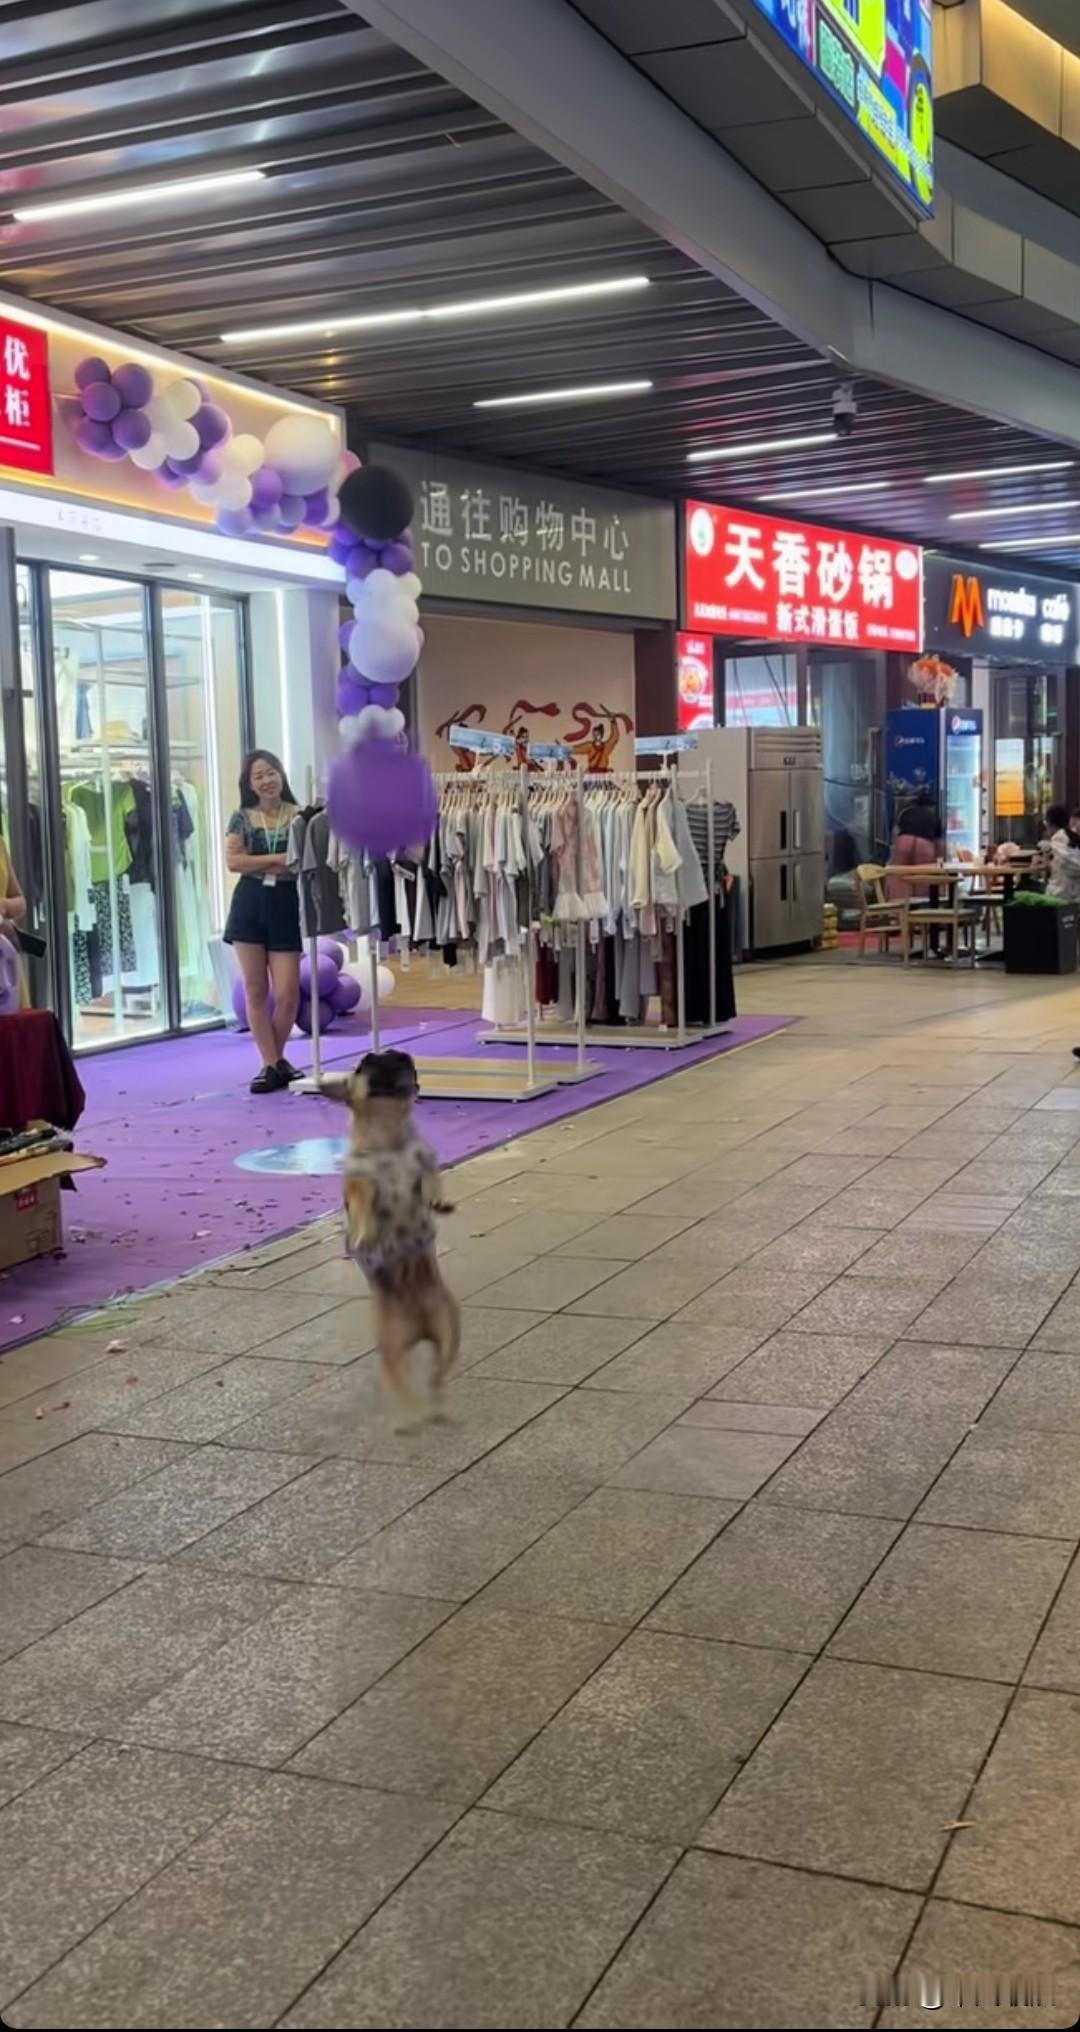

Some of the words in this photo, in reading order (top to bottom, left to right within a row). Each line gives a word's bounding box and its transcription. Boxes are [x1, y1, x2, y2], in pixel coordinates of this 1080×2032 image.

[420, 480, 629, 561] 通往购物中心
[421, 542, 452, 571] TO
[460, 547, 573, 586] SHOPPING
[578, 565, 631, 593] MALL
[724, 523, 893, 610] 天香砂锅
